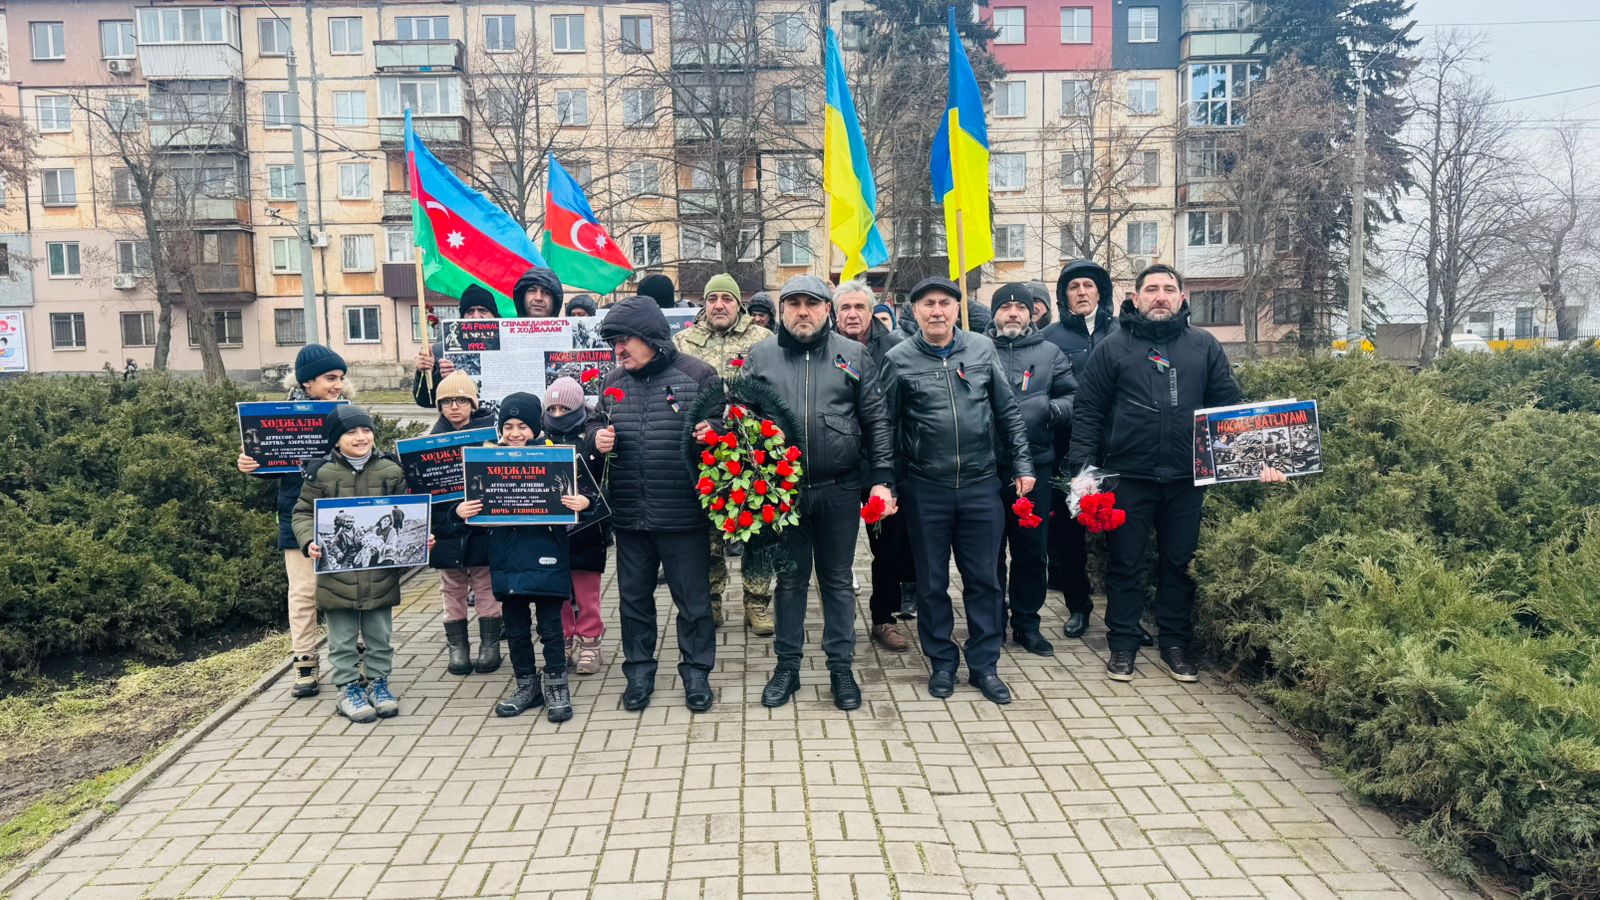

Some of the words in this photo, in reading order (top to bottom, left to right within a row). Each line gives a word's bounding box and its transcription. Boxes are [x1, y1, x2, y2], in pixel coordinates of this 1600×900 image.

[501, 319, 570, 328] СПРАВЕДЛИВОСТЬ
[467, 342, 486, 351] 1992
[260, 419, 323, 428] ХОДЖАЛЫ
[487, 466, 546, 475] ХОДЖАЛЫ
